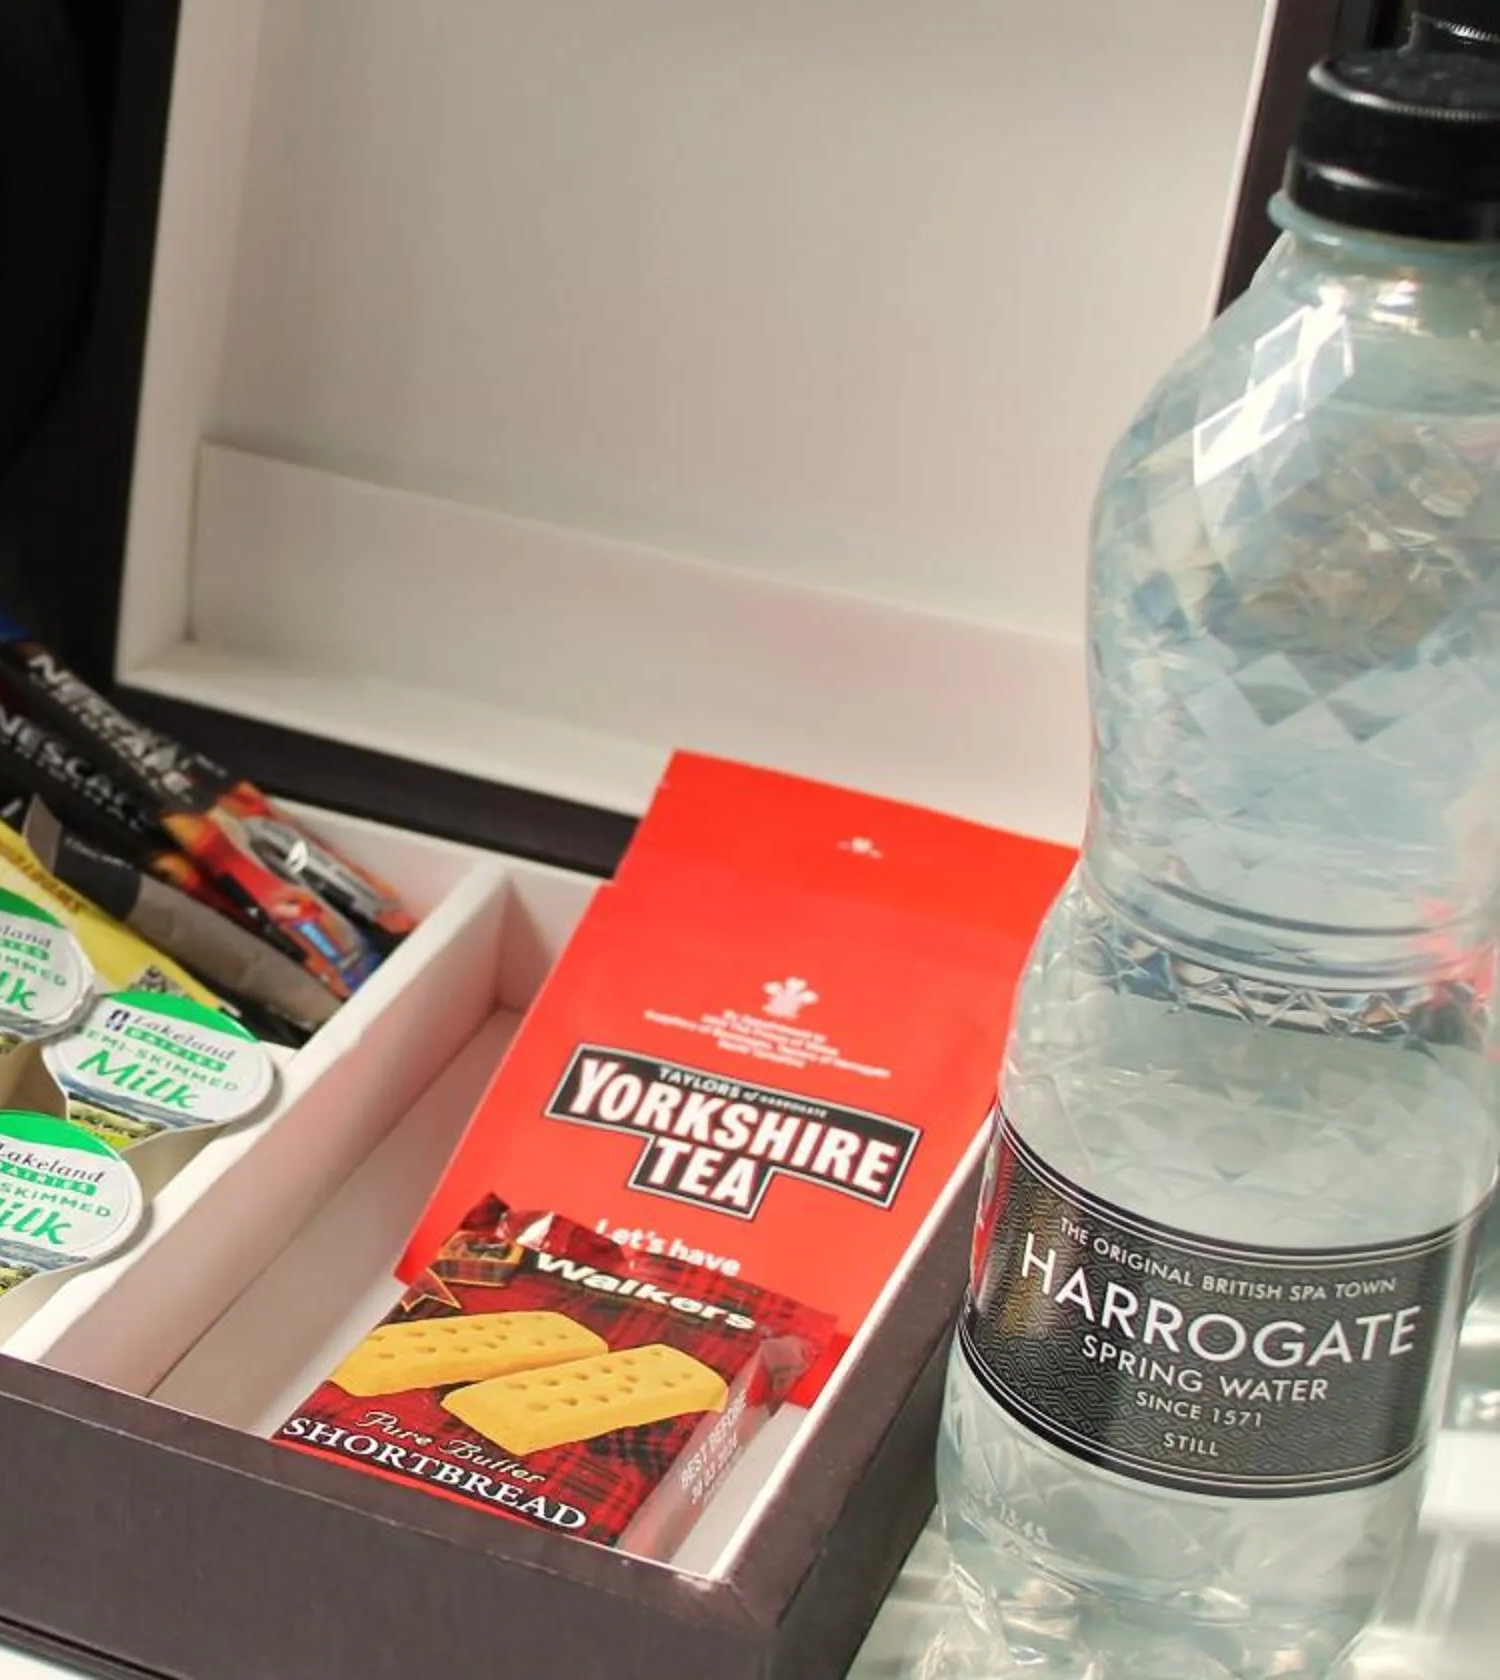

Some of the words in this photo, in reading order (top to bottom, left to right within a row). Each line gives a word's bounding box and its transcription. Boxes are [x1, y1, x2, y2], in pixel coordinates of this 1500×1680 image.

[133, 1014, 237, 1060] Lakeland
[76, 1050, 202, 1109] Milk
[658, 1066, 741, 1100] TAYLORS
[569, 1057, 898, 1194] YORKSHIRE
[648, 1136, 760, 1209] TEA
[595, 1218, 667, 1255] Let's
[669, 1238, 741, 1277] have
[1060, 1215, 1090, 1246] THE
[1093, 1238, 1195, 1287] ORIGINAL
[1201, 1275, 1283, 1300] BRITISH
[1289, 1285, 1328, 1301] SPA
[1335, 1277, 1397, 1298] TOWN
[536, 1251, 757, 1330] Walkers
[1020, 1232, 1422, 1368] HARROGATE
[1081, 1334, 1204, 1393] SPRING
[1219, 1375, 1329, 1402] WATER
[1135, 1390, 1201, 1421] SINCE
[1212, 1407, 1263, 1427] 1571
[282, 1416, 588, 1531] SHORTBREAD
[355, 1410, 434, 1448] Pure
[437, 1439, 547, 1484] Butter
[1163, 1432, 1220, 1457] STILL
